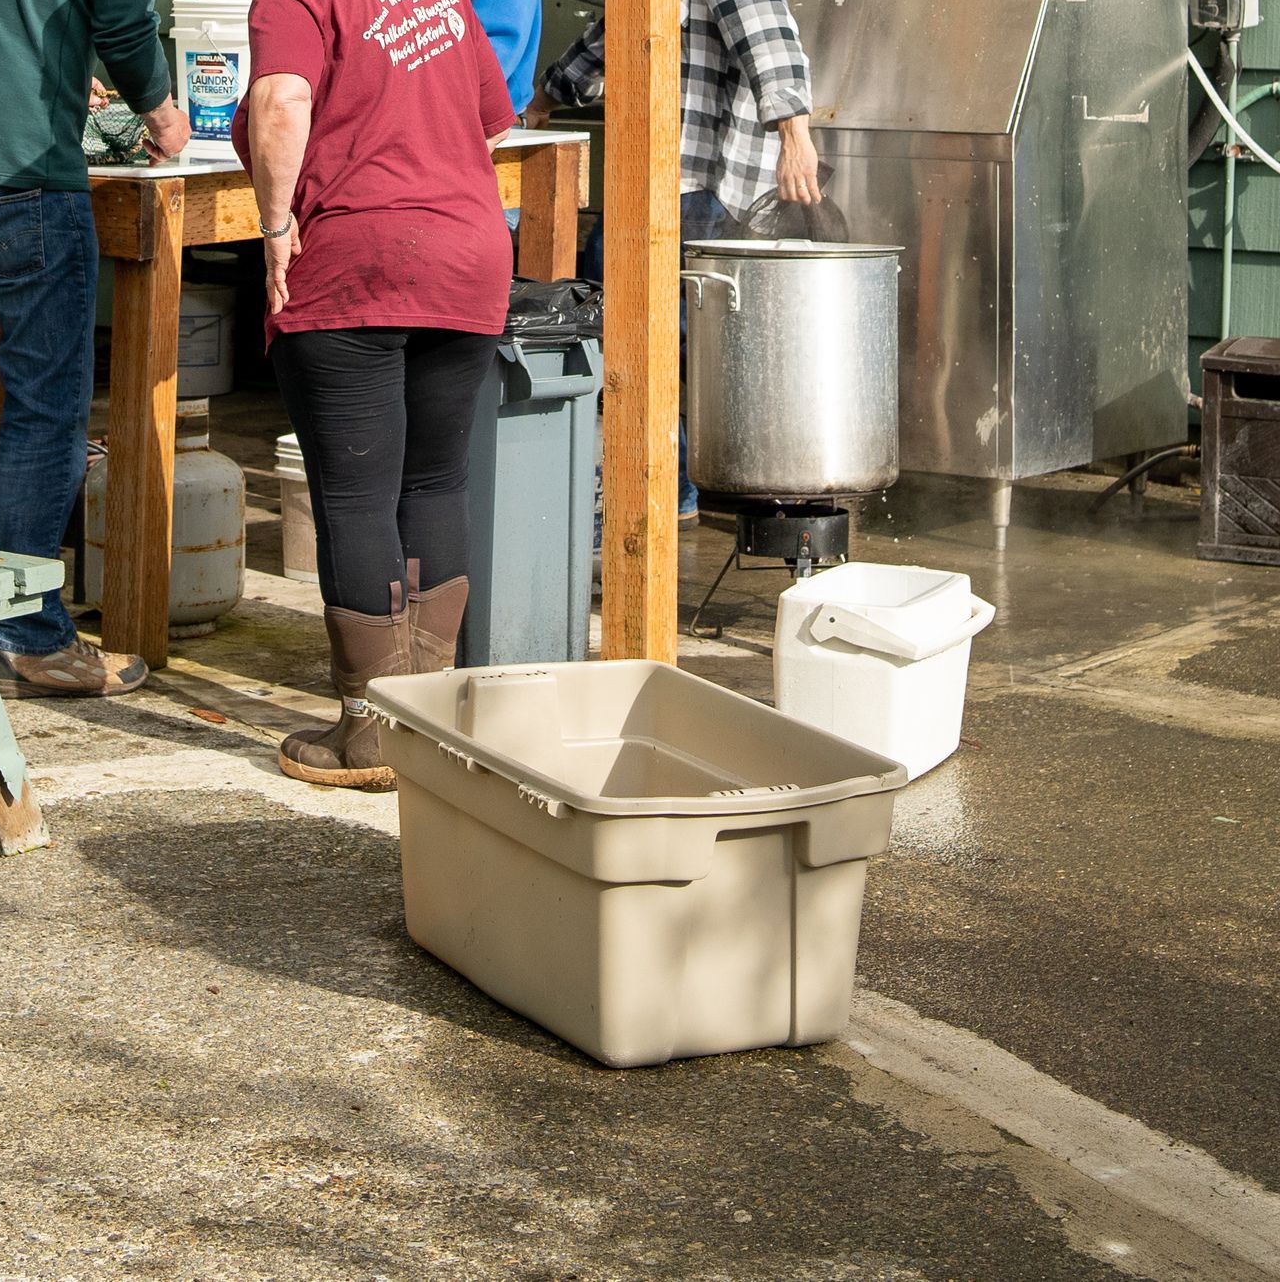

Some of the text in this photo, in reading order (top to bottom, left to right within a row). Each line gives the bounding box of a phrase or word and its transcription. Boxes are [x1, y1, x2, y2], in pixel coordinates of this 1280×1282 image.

[363, 6, 389, 40] Original
[414, 19, 449, 50] Festival
[191, 75, 235, 85] LAUNDRY
[192, 85, 233, 94] DETERGENT
